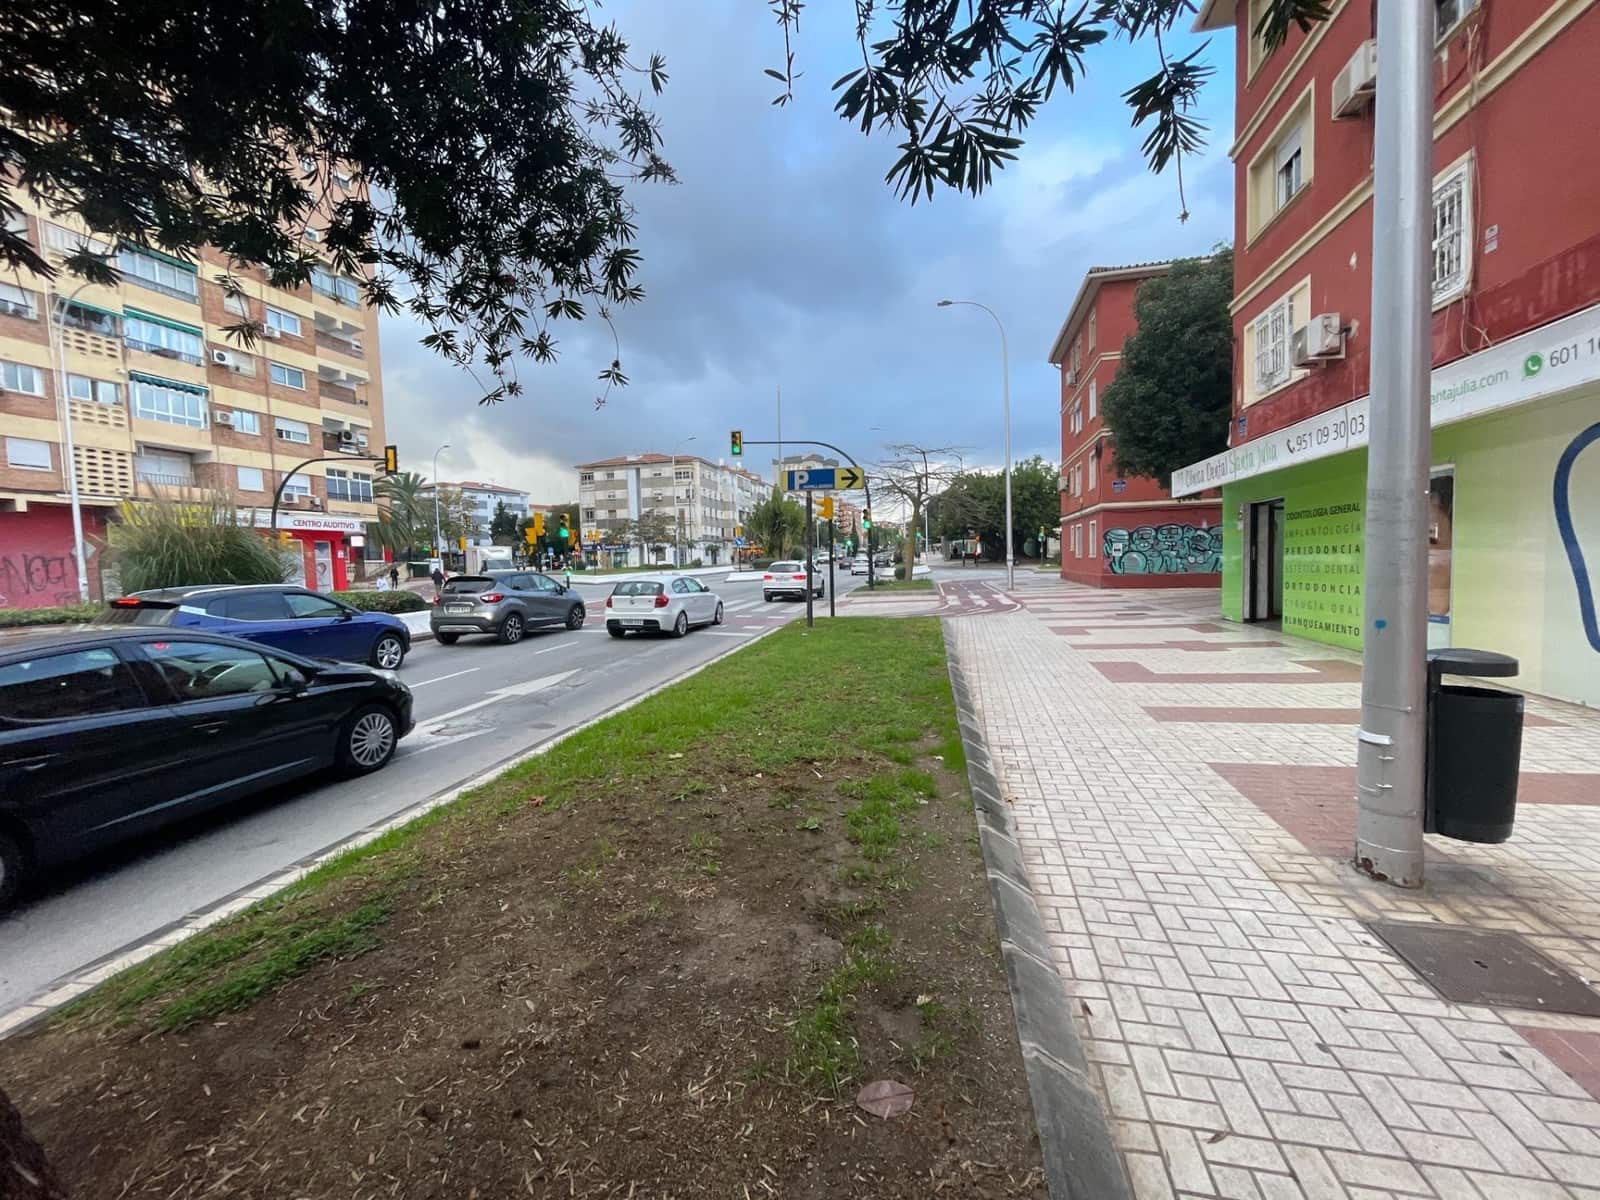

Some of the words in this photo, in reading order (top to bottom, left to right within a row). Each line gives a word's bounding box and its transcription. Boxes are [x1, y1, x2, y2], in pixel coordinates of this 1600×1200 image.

[1550, 343, 1578, 367] 601
[1587, 337, 1600, 356] 1
[1296, 432, 1313, 453] 951
[1316, 426, 1330, 445] 09
[1333, 420, 1346, 441] 30
[1350, 414, 1365, 436] 03
[794, 471, 809, 490] P
[1329, 503, 1360, 515] GENERAL
[293, 519, 321, 528] CENTRO
[323, 520, 355, 529] AUDITIVO
[1325, 564, 1360, 574] DENTAL
[1285, 582, 1360, 595] ORTODONCIA
[1331, 603, 1360, 616] ORAL
[1284, 616, 1360, 636] BLANQUEAMIENTO
